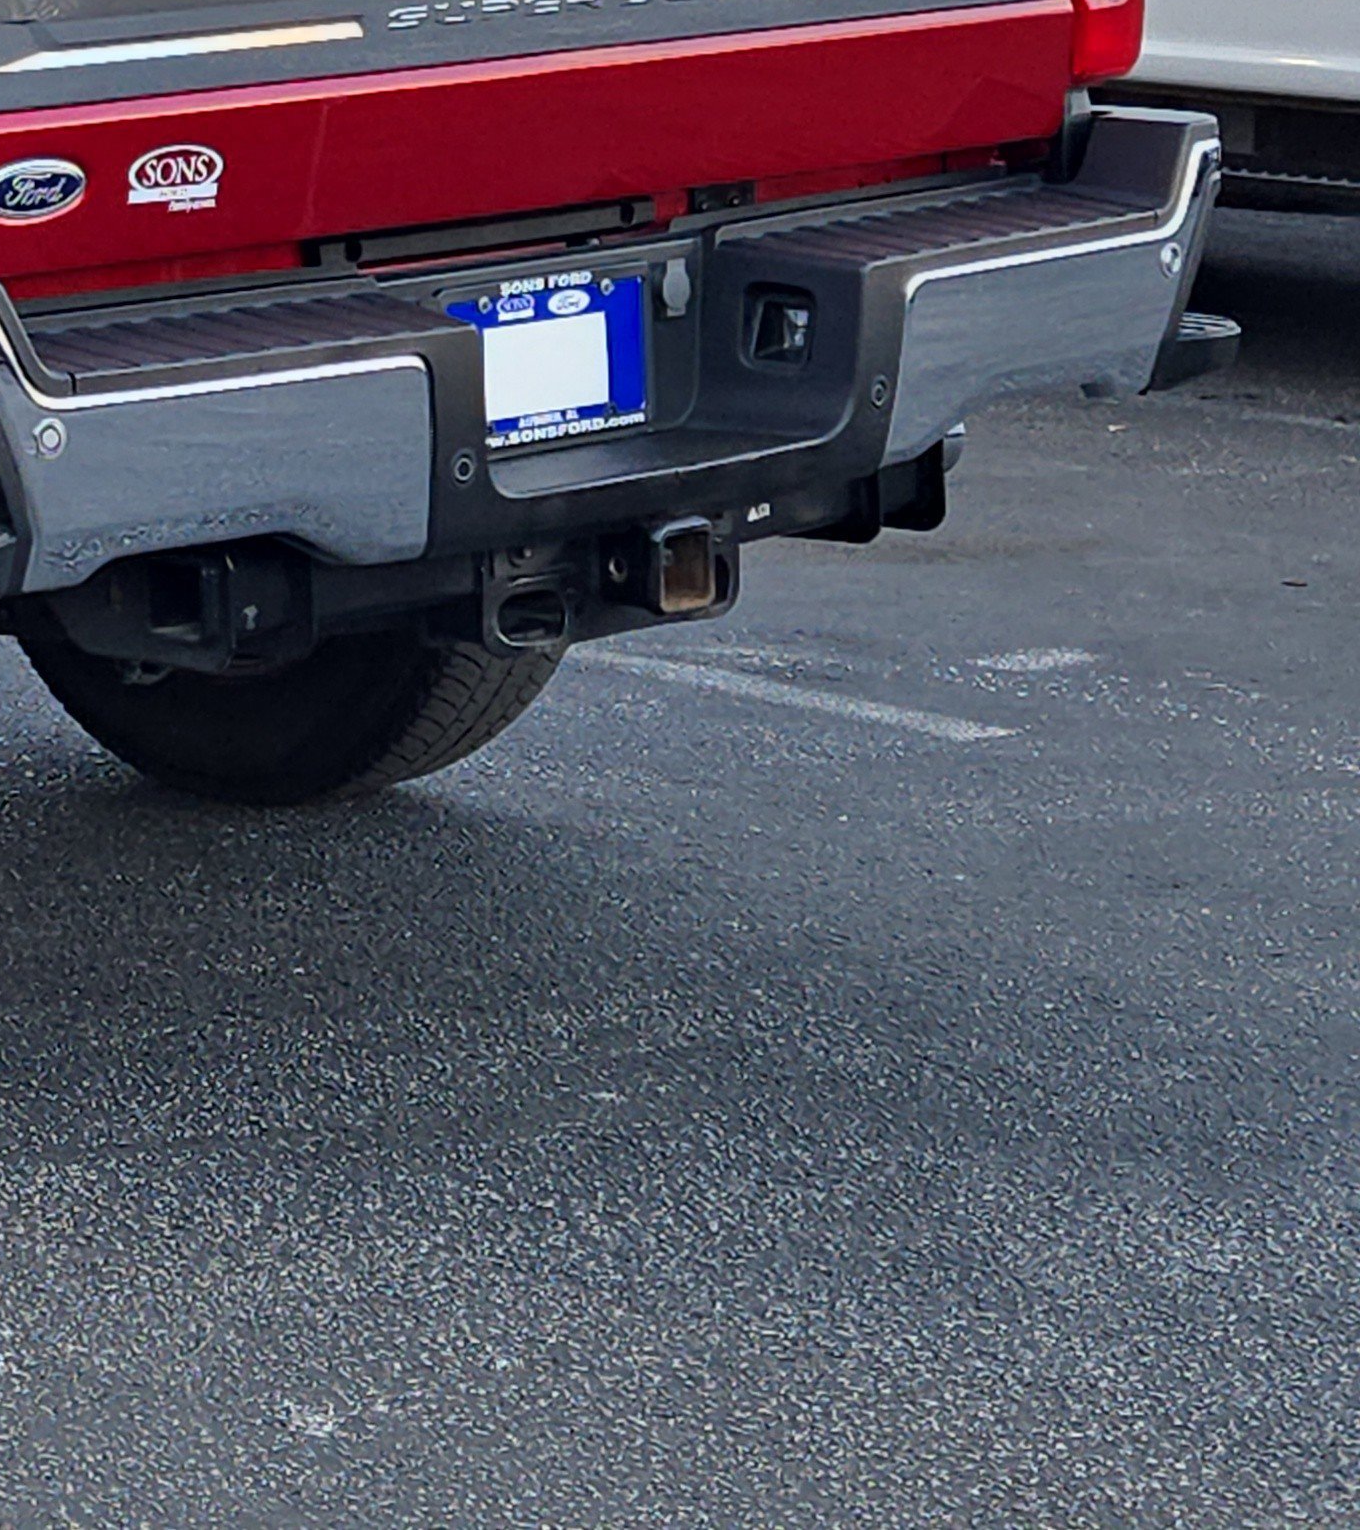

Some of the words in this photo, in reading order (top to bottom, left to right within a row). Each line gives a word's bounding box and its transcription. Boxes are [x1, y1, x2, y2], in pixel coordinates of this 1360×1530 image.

[142, 154, 210, 187] SONS
[4, 173, 67, 207] Ford
[499, 276, 545, 296] SONS
[547, 270, 593, 289] FORD
